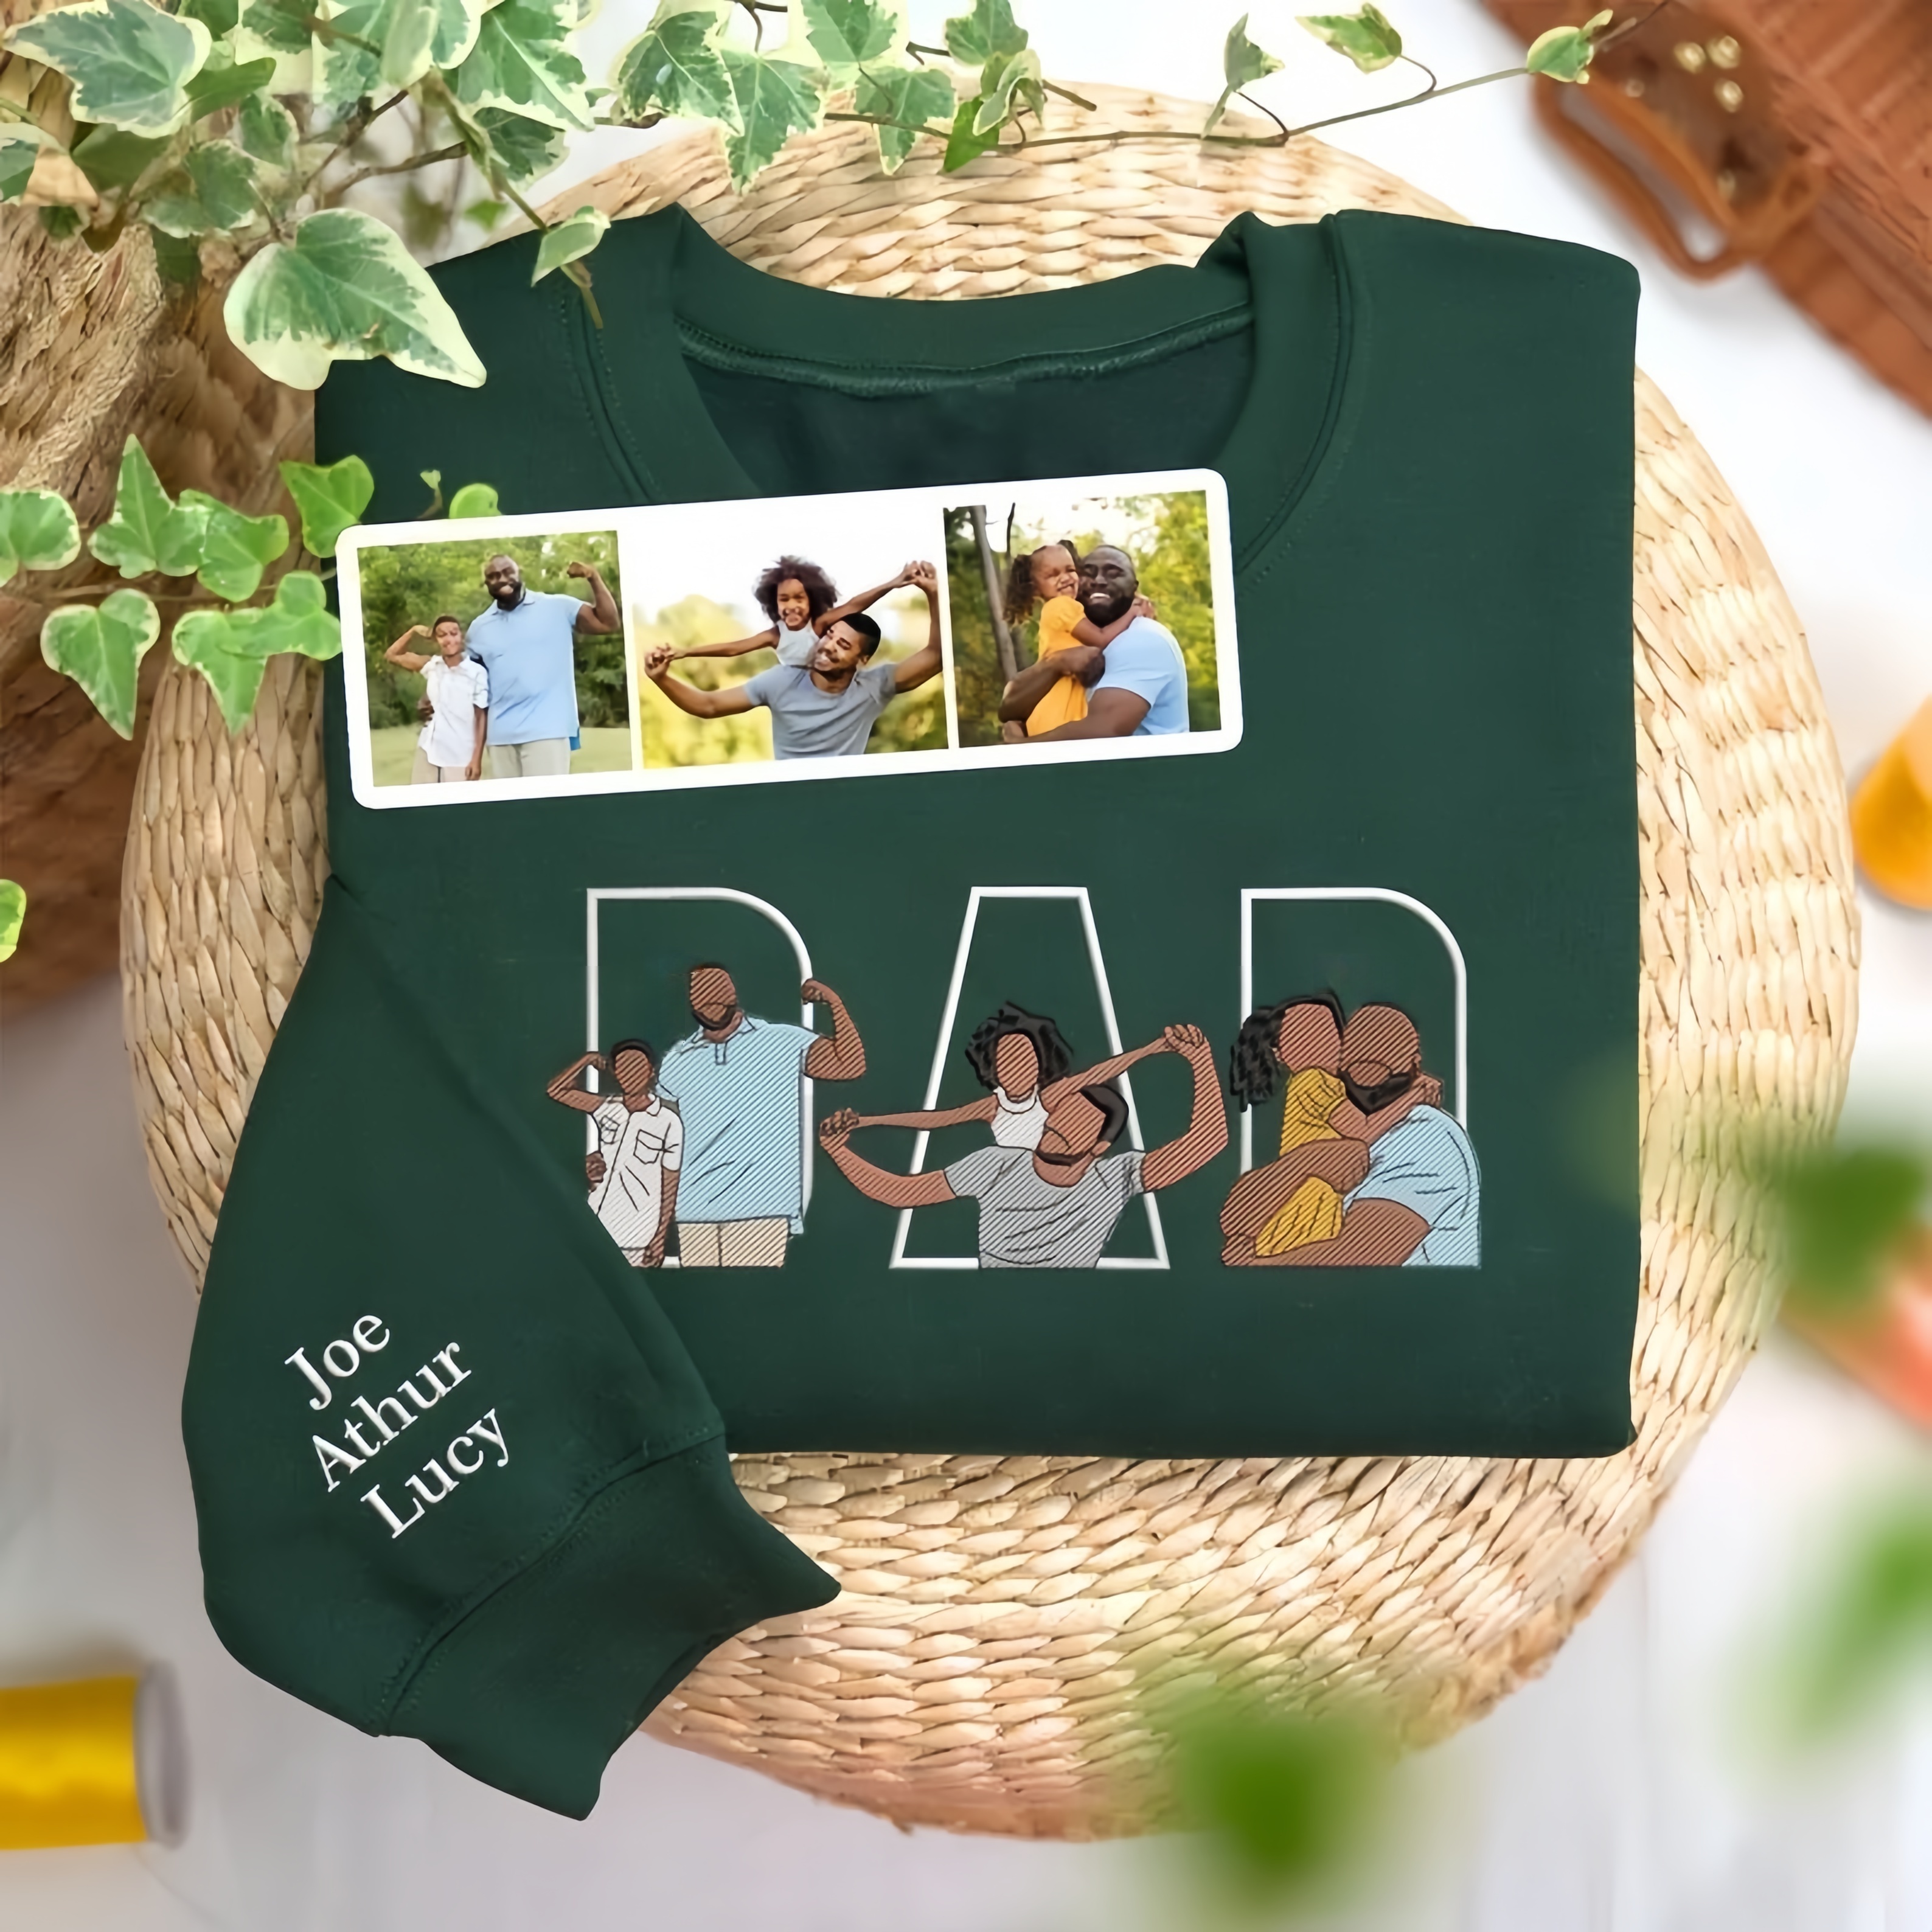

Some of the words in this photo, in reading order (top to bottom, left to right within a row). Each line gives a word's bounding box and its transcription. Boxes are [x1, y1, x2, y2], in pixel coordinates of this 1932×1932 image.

[586, 886, 1470, 1269] DAD
[284, 1315, 390, 1411] Joe
[312, 1342, 472, 1493] Athur
[360, 1408, 509, 1539] Lucy
